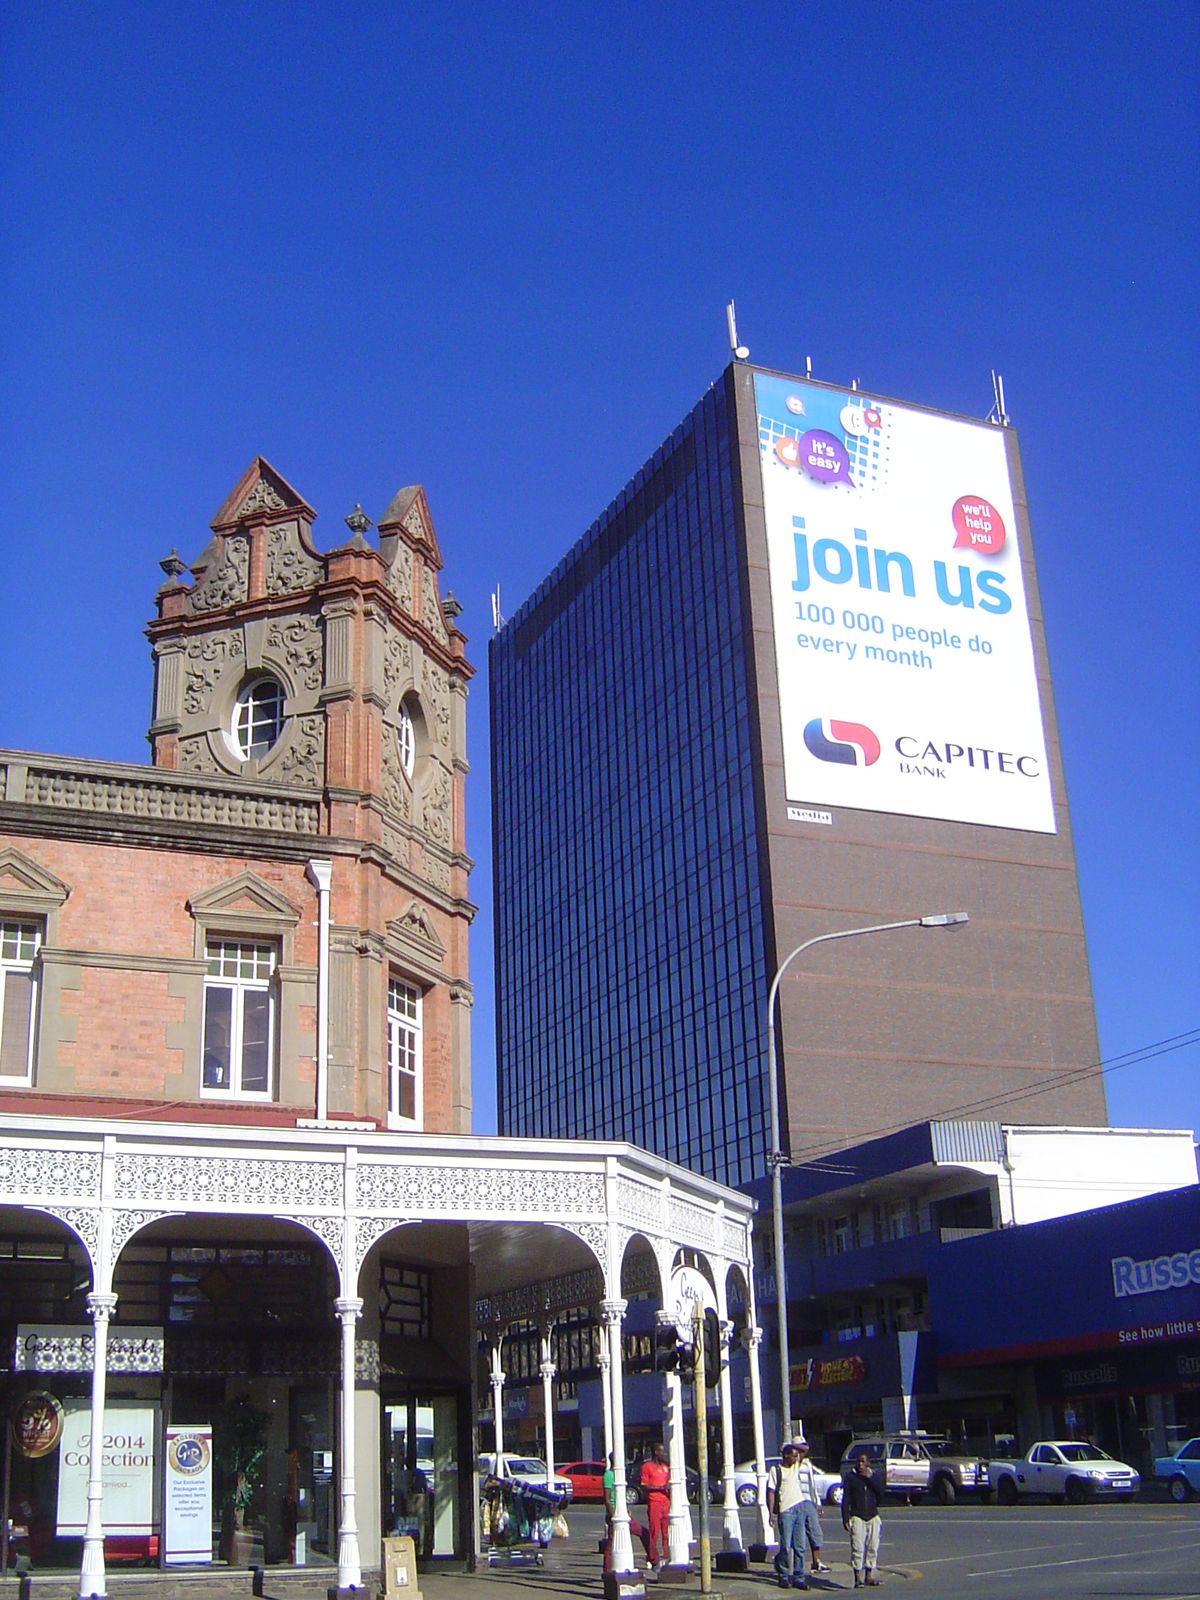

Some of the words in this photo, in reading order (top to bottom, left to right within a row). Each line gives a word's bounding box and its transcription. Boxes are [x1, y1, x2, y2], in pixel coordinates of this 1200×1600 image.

[812, 440, 835, 457] it's
[808, 455, 840, 474] easy
[962, 504, 991, 518] we'll
[965, 515, 992, 533] help
[970, 532, 992, 545] you
[792, 515, 916, 598] join
[933, 560, 1012, 615] us
[795, 602, 836, 625] 100
[842, 610, 884, 634] 000
[892, 623, 962, 649] people
[968, 635, 993, 655] do
[797, 633, 857, 660] every
[865, 645, 933, 670] month
[895, 736, 1040, 777] CAPITEC
[900, 763, 946, 779] BANK
[1119, 1330, 1138, 1342] See
[1141, 1327, 1163, 1339] how
[1167, 1321, 1194, 1335] little
[103, 1435, 145, 1449] 2014
[64, 1452, 155, 1467] Coection
